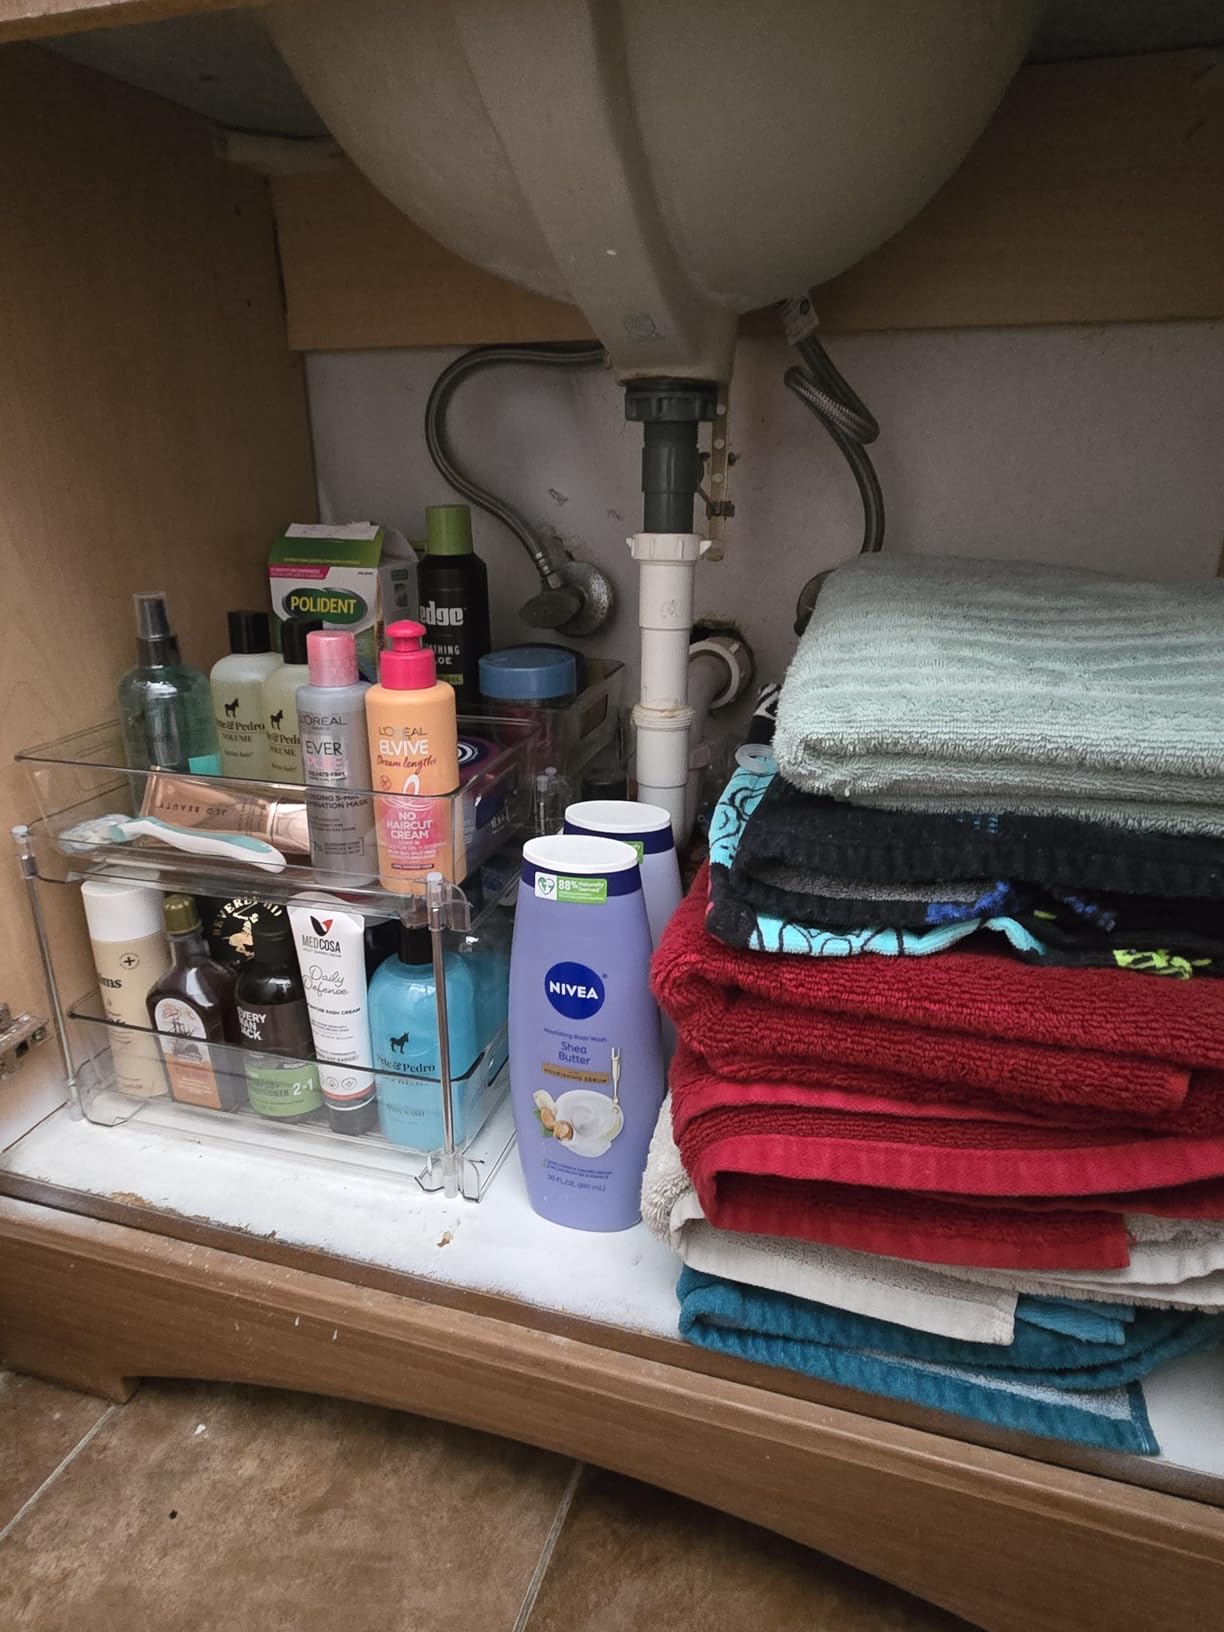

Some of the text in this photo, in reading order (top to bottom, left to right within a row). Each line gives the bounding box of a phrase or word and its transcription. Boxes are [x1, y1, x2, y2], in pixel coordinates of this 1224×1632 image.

[289, 596, 357, 615] POLIDENT
[305, 740, 343, 756] EVER
[379, 739, 429, 756] ELVIVE
[376, 754, 437, 775] Dream lengths
[398, 811, 417, 821] NO
[386, 820, 433, 831] HAIRCUT
[390, 830, 429, 840] CREAM
[558, 879, 578, 892] 88%
[301, 935, 342, 953] MEDCOSA
[309, 965, 345, 988] Daily
[549, 980, 599, 1001] NIVEA
[561, 1041, 587, 1055] Shea
[558, 1051, 591, 1065] Butter
